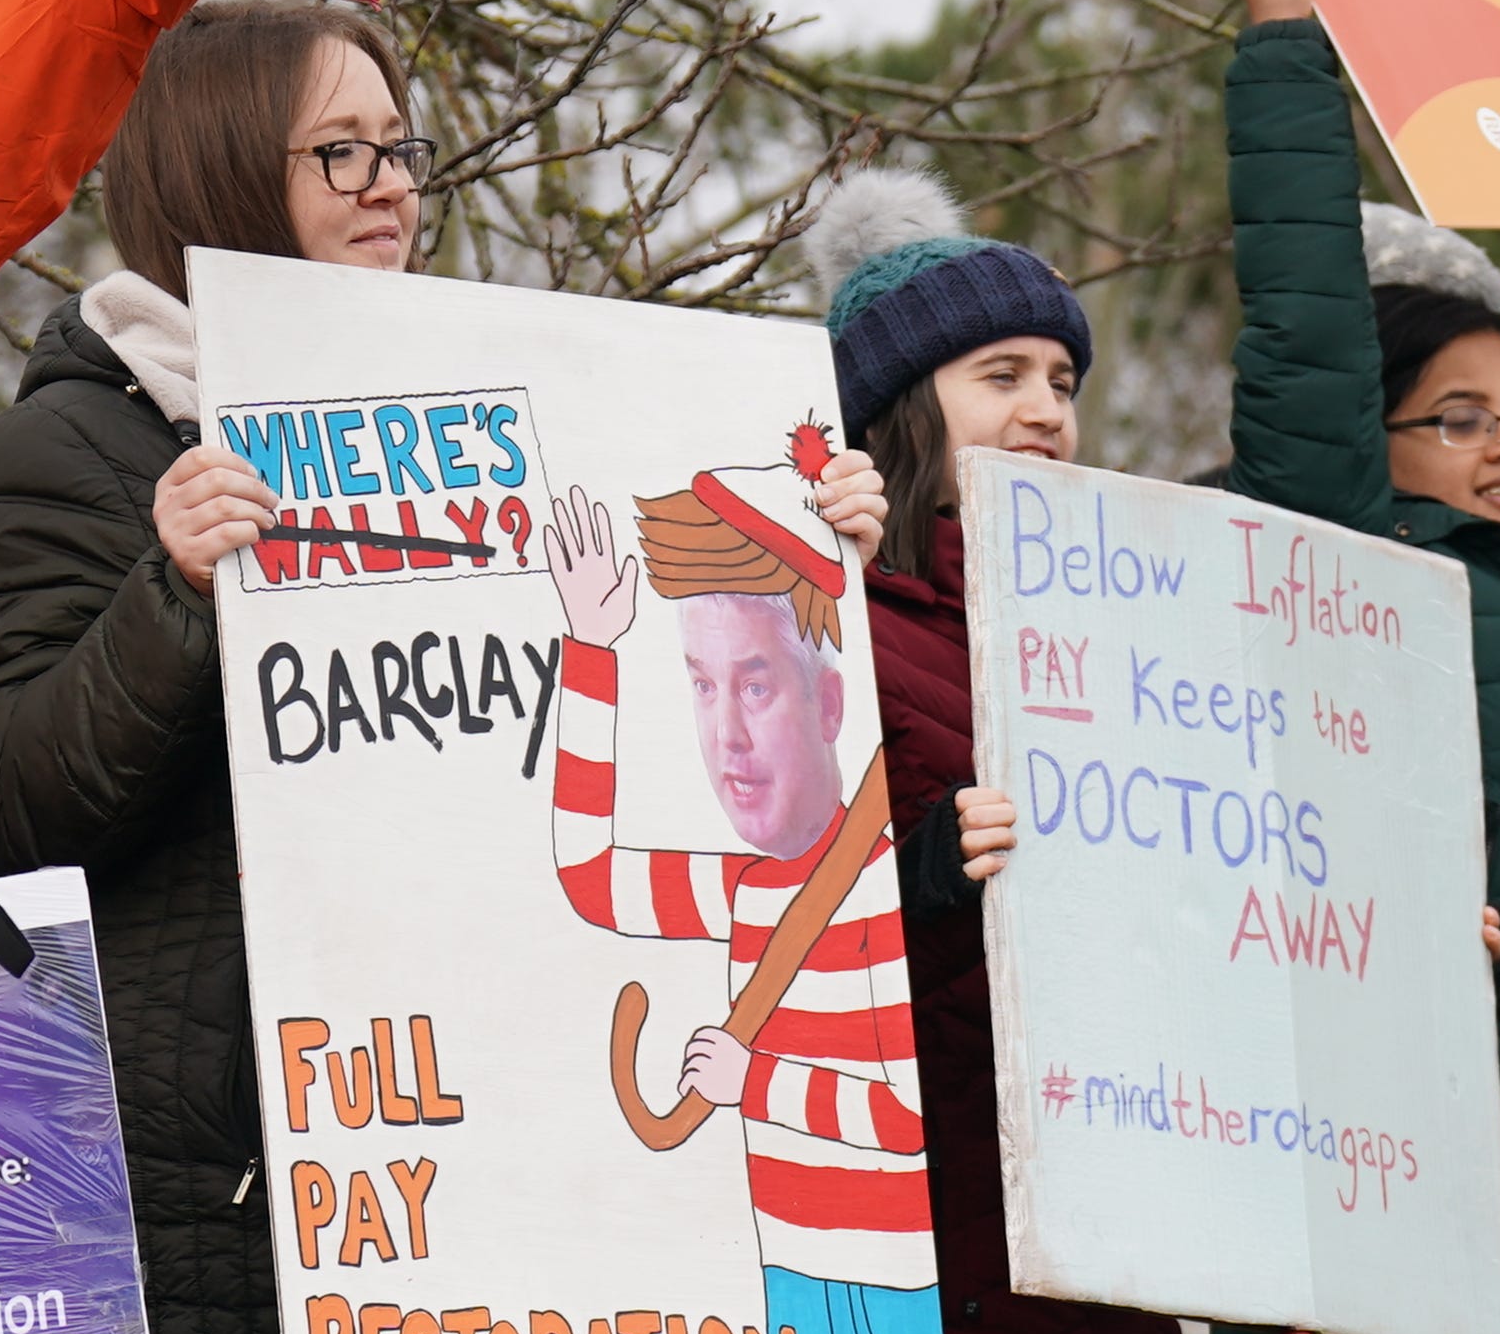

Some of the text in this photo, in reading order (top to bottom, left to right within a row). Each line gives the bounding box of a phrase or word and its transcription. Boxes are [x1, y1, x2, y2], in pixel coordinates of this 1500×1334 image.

[220, 403, 527, 500] WHERE'S
[253, 496, 532, 584] WALLY?
[1009, 479, 1402, 648] Below Inflation
[259, 631, 561, 780] BARCLAY
[1017, 626, 1090, 700] PAY
[1314, 692, 1370, 755] the
[1027, 747, 1328, 887] DOCTORS
[1230, 886, 1375, 981] AWAY
[278, 1015, 462, 1133] FULL
[1042, 1062, 1420, 1212] #mindtherotagaps
[292, 1156, 438, 1268] PAY
